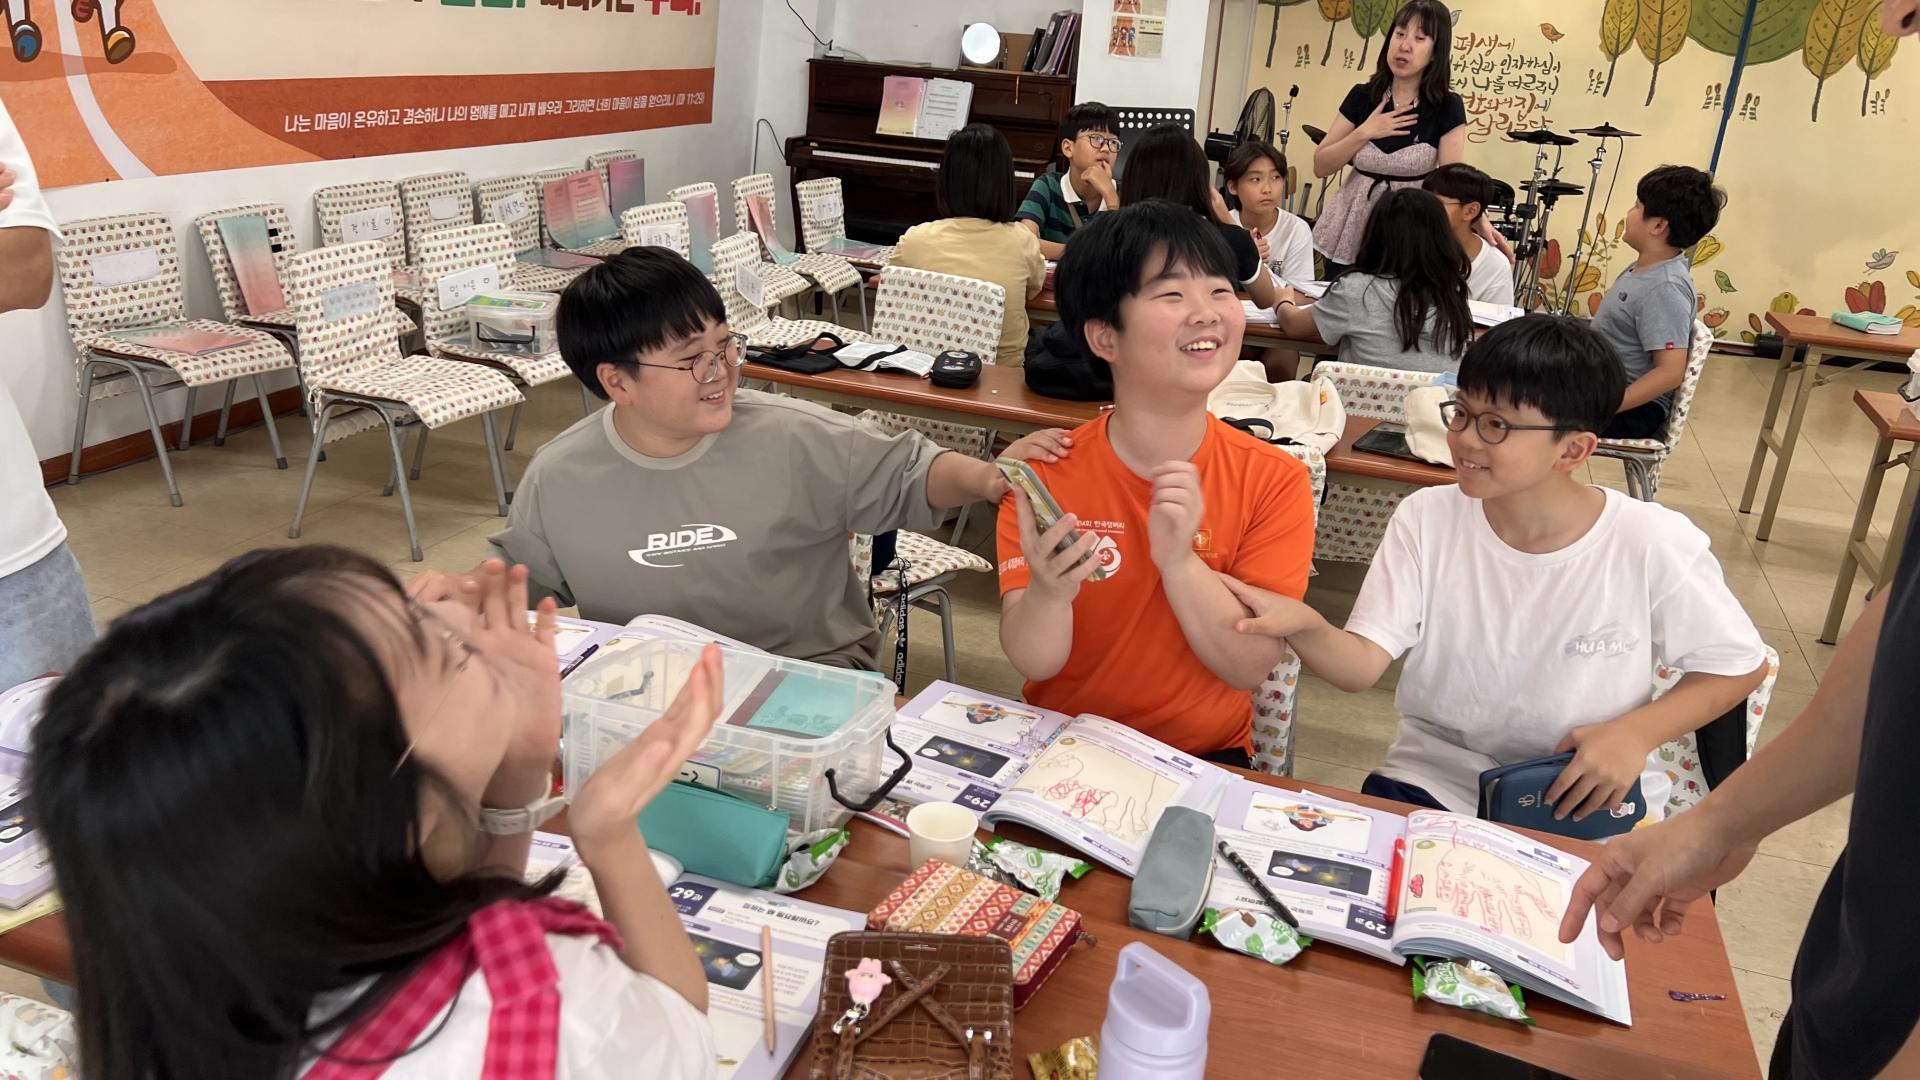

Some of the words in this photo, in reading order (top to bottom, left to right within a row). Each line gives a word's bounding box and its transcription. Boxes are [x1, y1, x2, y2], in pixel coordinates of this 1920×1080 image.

[1450, 53, 1498, 75] 하심과
[285, 114, 312, 133] 나는
[314, 112, 351, 131] 마음이
[354, 109, 400, 129] 온유하고
[403, 107, 446, 126] 겸손하니
[447, 106, 468, 122] 나의
[470, 104, 498, 121] 멍에를
[499, 102, 517, 119] 메고
[518, 101, 536, 117] 내게
[537, 100, 563, 116] 배우라
[564, 98, 595, 114] 그리하면
[611, 96, 633, 111] 마음이
[647, 526, 714, 550] RIDE
[898, 593, 908, 631] adidas
[895, 652, 905, 685] adidas
